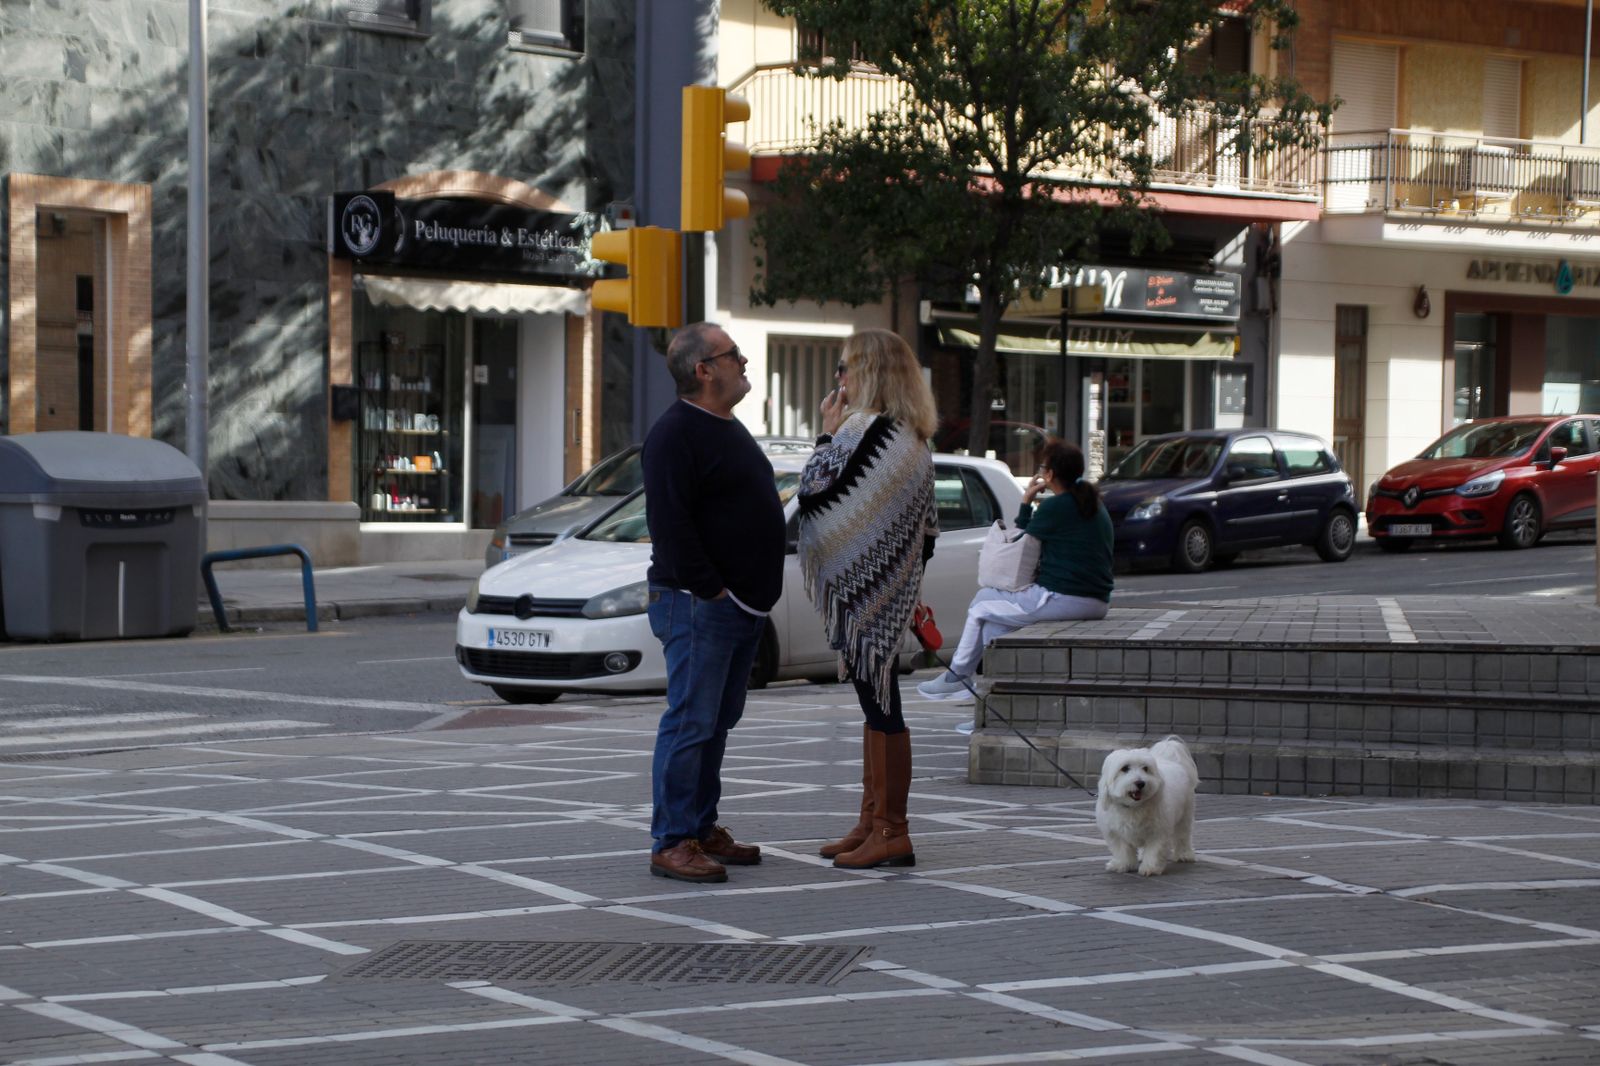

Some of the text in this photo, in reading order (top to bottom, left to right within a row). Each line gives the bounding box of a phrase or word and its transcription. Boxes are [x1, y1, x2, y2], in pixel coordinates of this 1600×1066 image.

[415, 219, 576, 250] Peluquería & Estética
[1046, 325, 1133, 351] CIBUM
[496, 631, 525, 646] 4530
